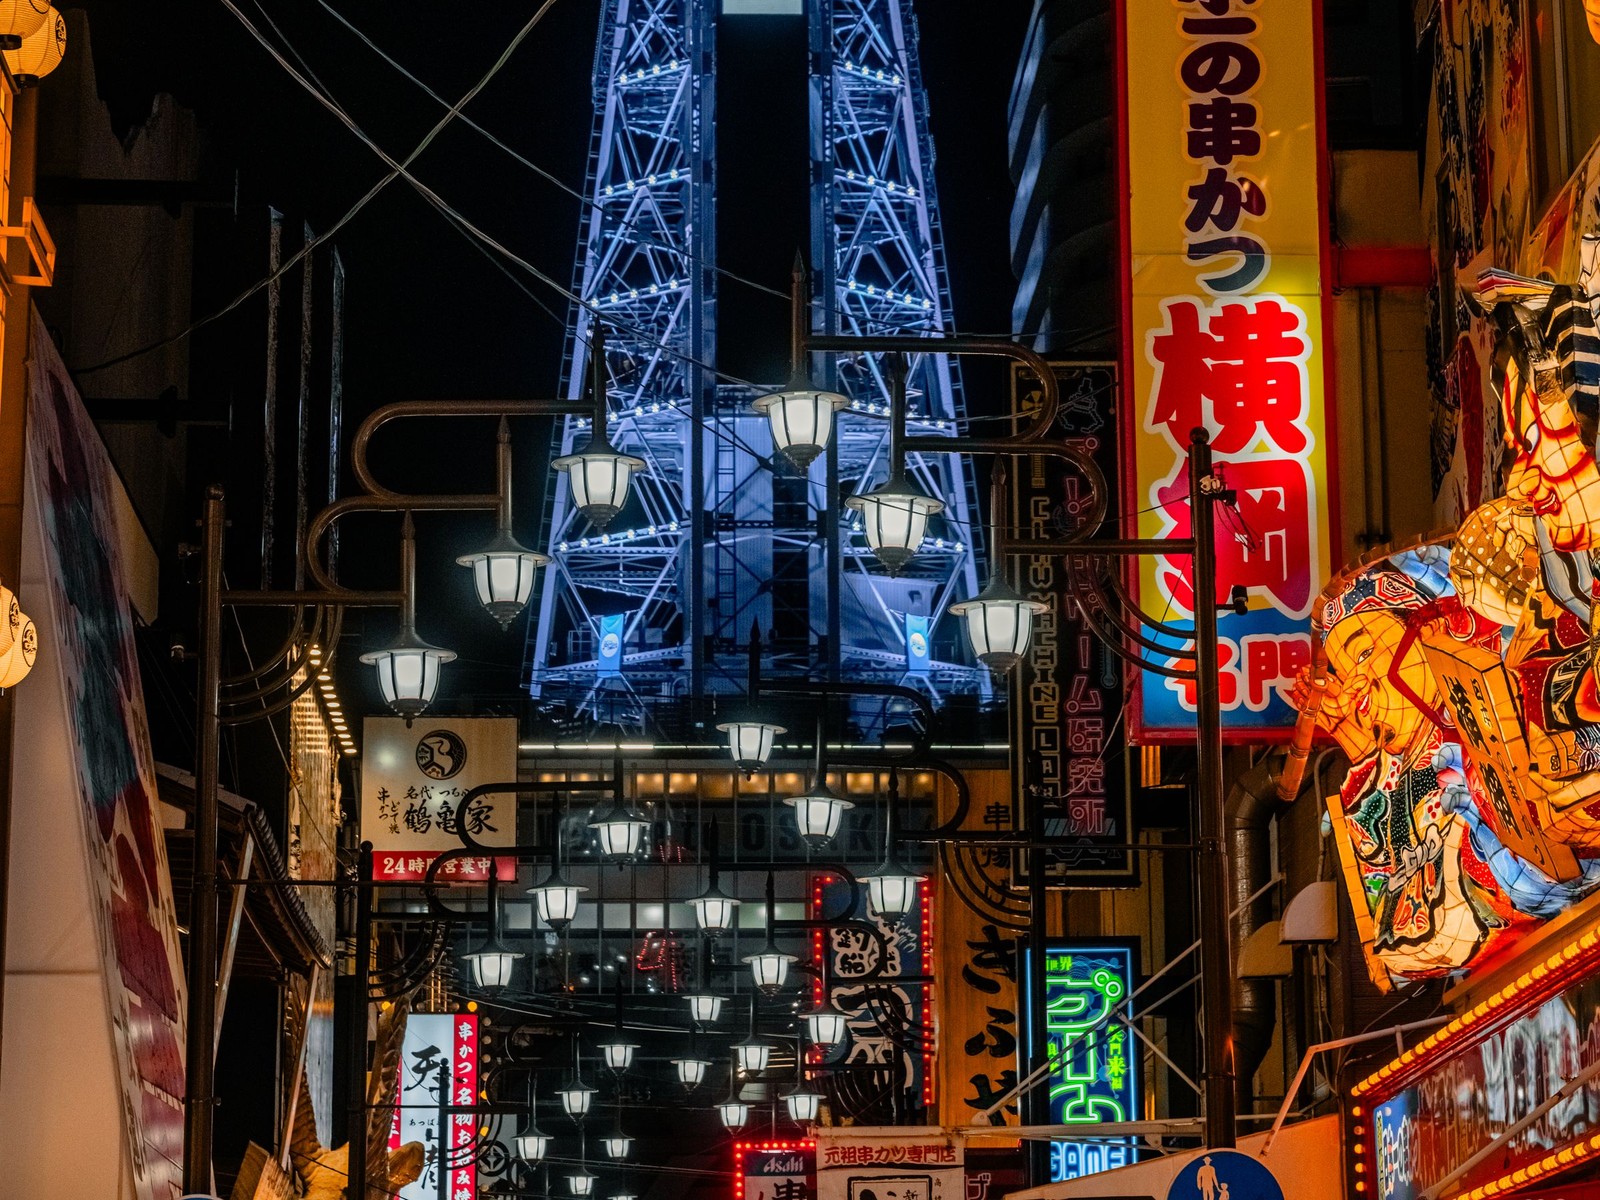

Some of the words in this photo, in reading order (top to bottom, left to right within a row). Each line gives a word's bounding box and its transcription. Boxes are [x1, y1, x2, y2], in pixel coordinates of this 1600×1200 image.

[1150, 299, 1312, 615] 横綱
[403, 800, 498, 835] 鶴亀家
[763, 1156, 804, 1173] Asahi
[824, 1145, 956, 1164] 元祖串カツ専門店
[1051, 1138, 1127, 1183] GAME
